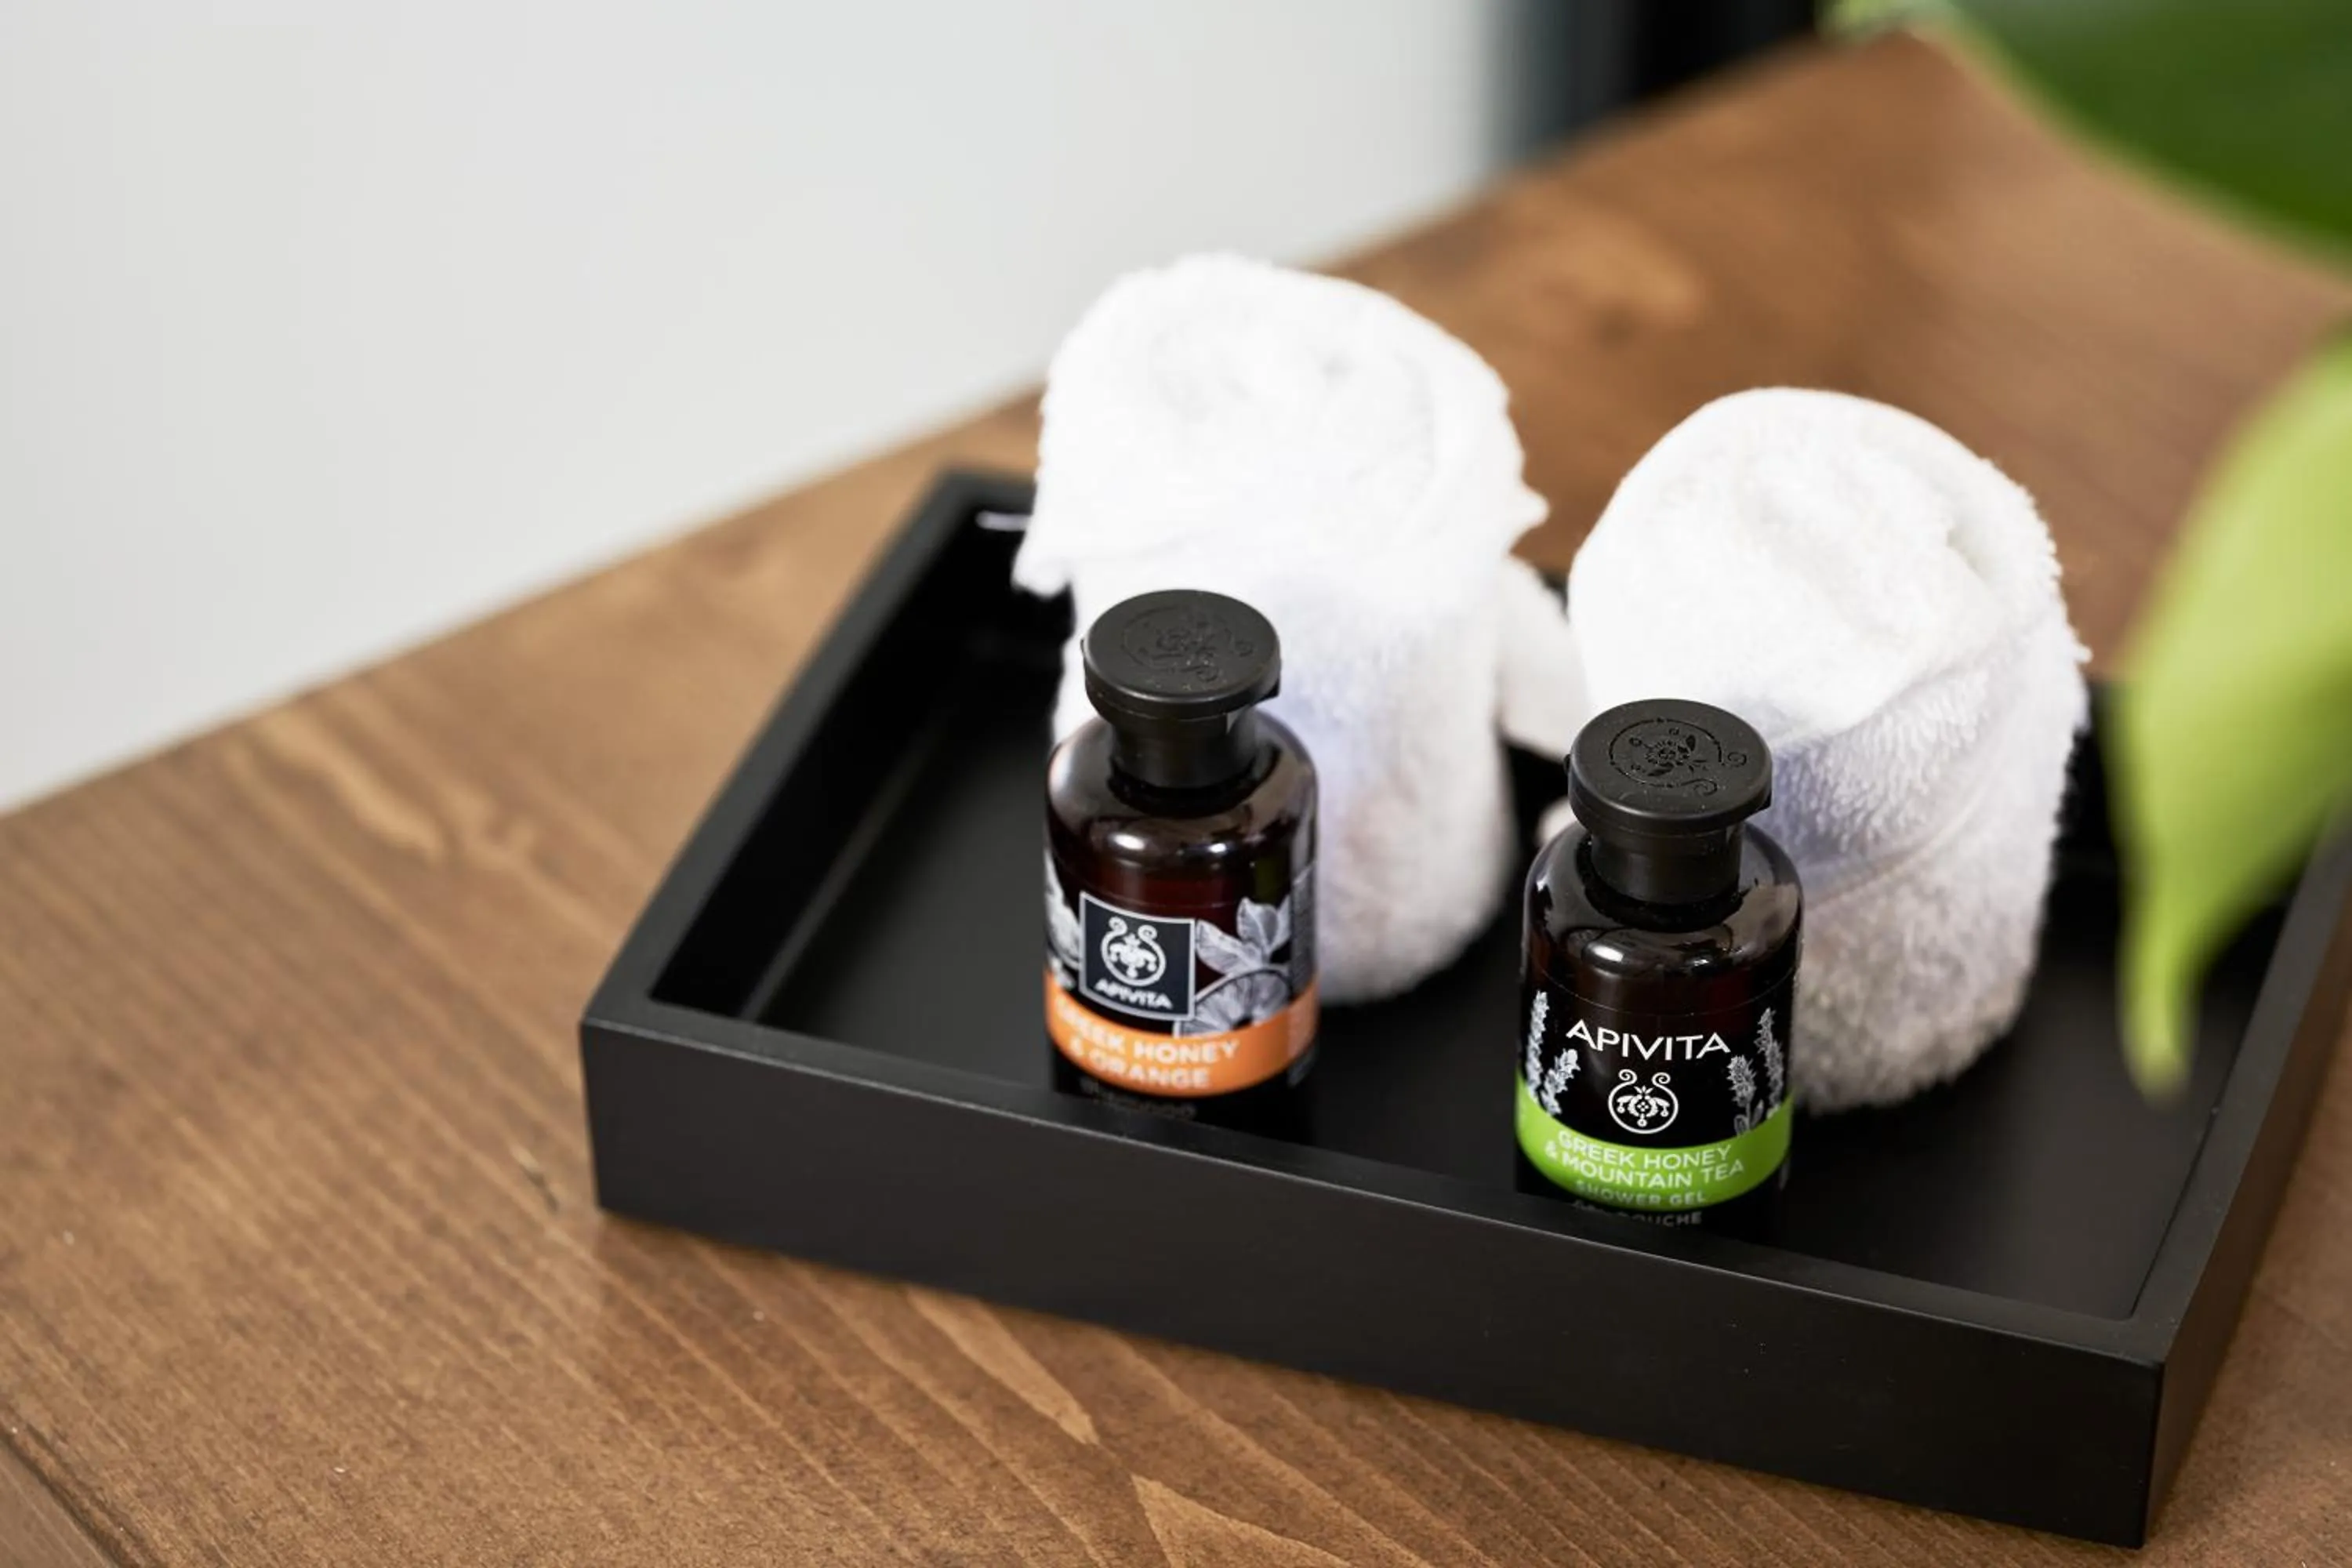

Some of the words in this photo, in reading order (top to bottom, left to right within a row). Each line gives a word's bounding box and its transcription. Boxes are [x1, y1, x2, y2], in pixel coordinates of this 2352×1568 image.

[1094, 978, 1174, 1010] APIVITA
[1133, 1040, 1240, 1065] HONEY
[1566, 1019, 1731, 1062] APIVITA
[1089, 1048, 1210, 1090] ORANGE
[1544, 1140, 1558, 1160] &
[1561, 1151, 1693, 1189] MOUNTAIN
[1700, 1159, 1745, 1185] TEA
[1558, 1130, 1635, 1169] GREEK
[1643, 1145, 1732, 1171] HONEY
[1575, 1179, 1662, 1207] SHOWER
[1669, 1189, 1707, 1207] GEL
